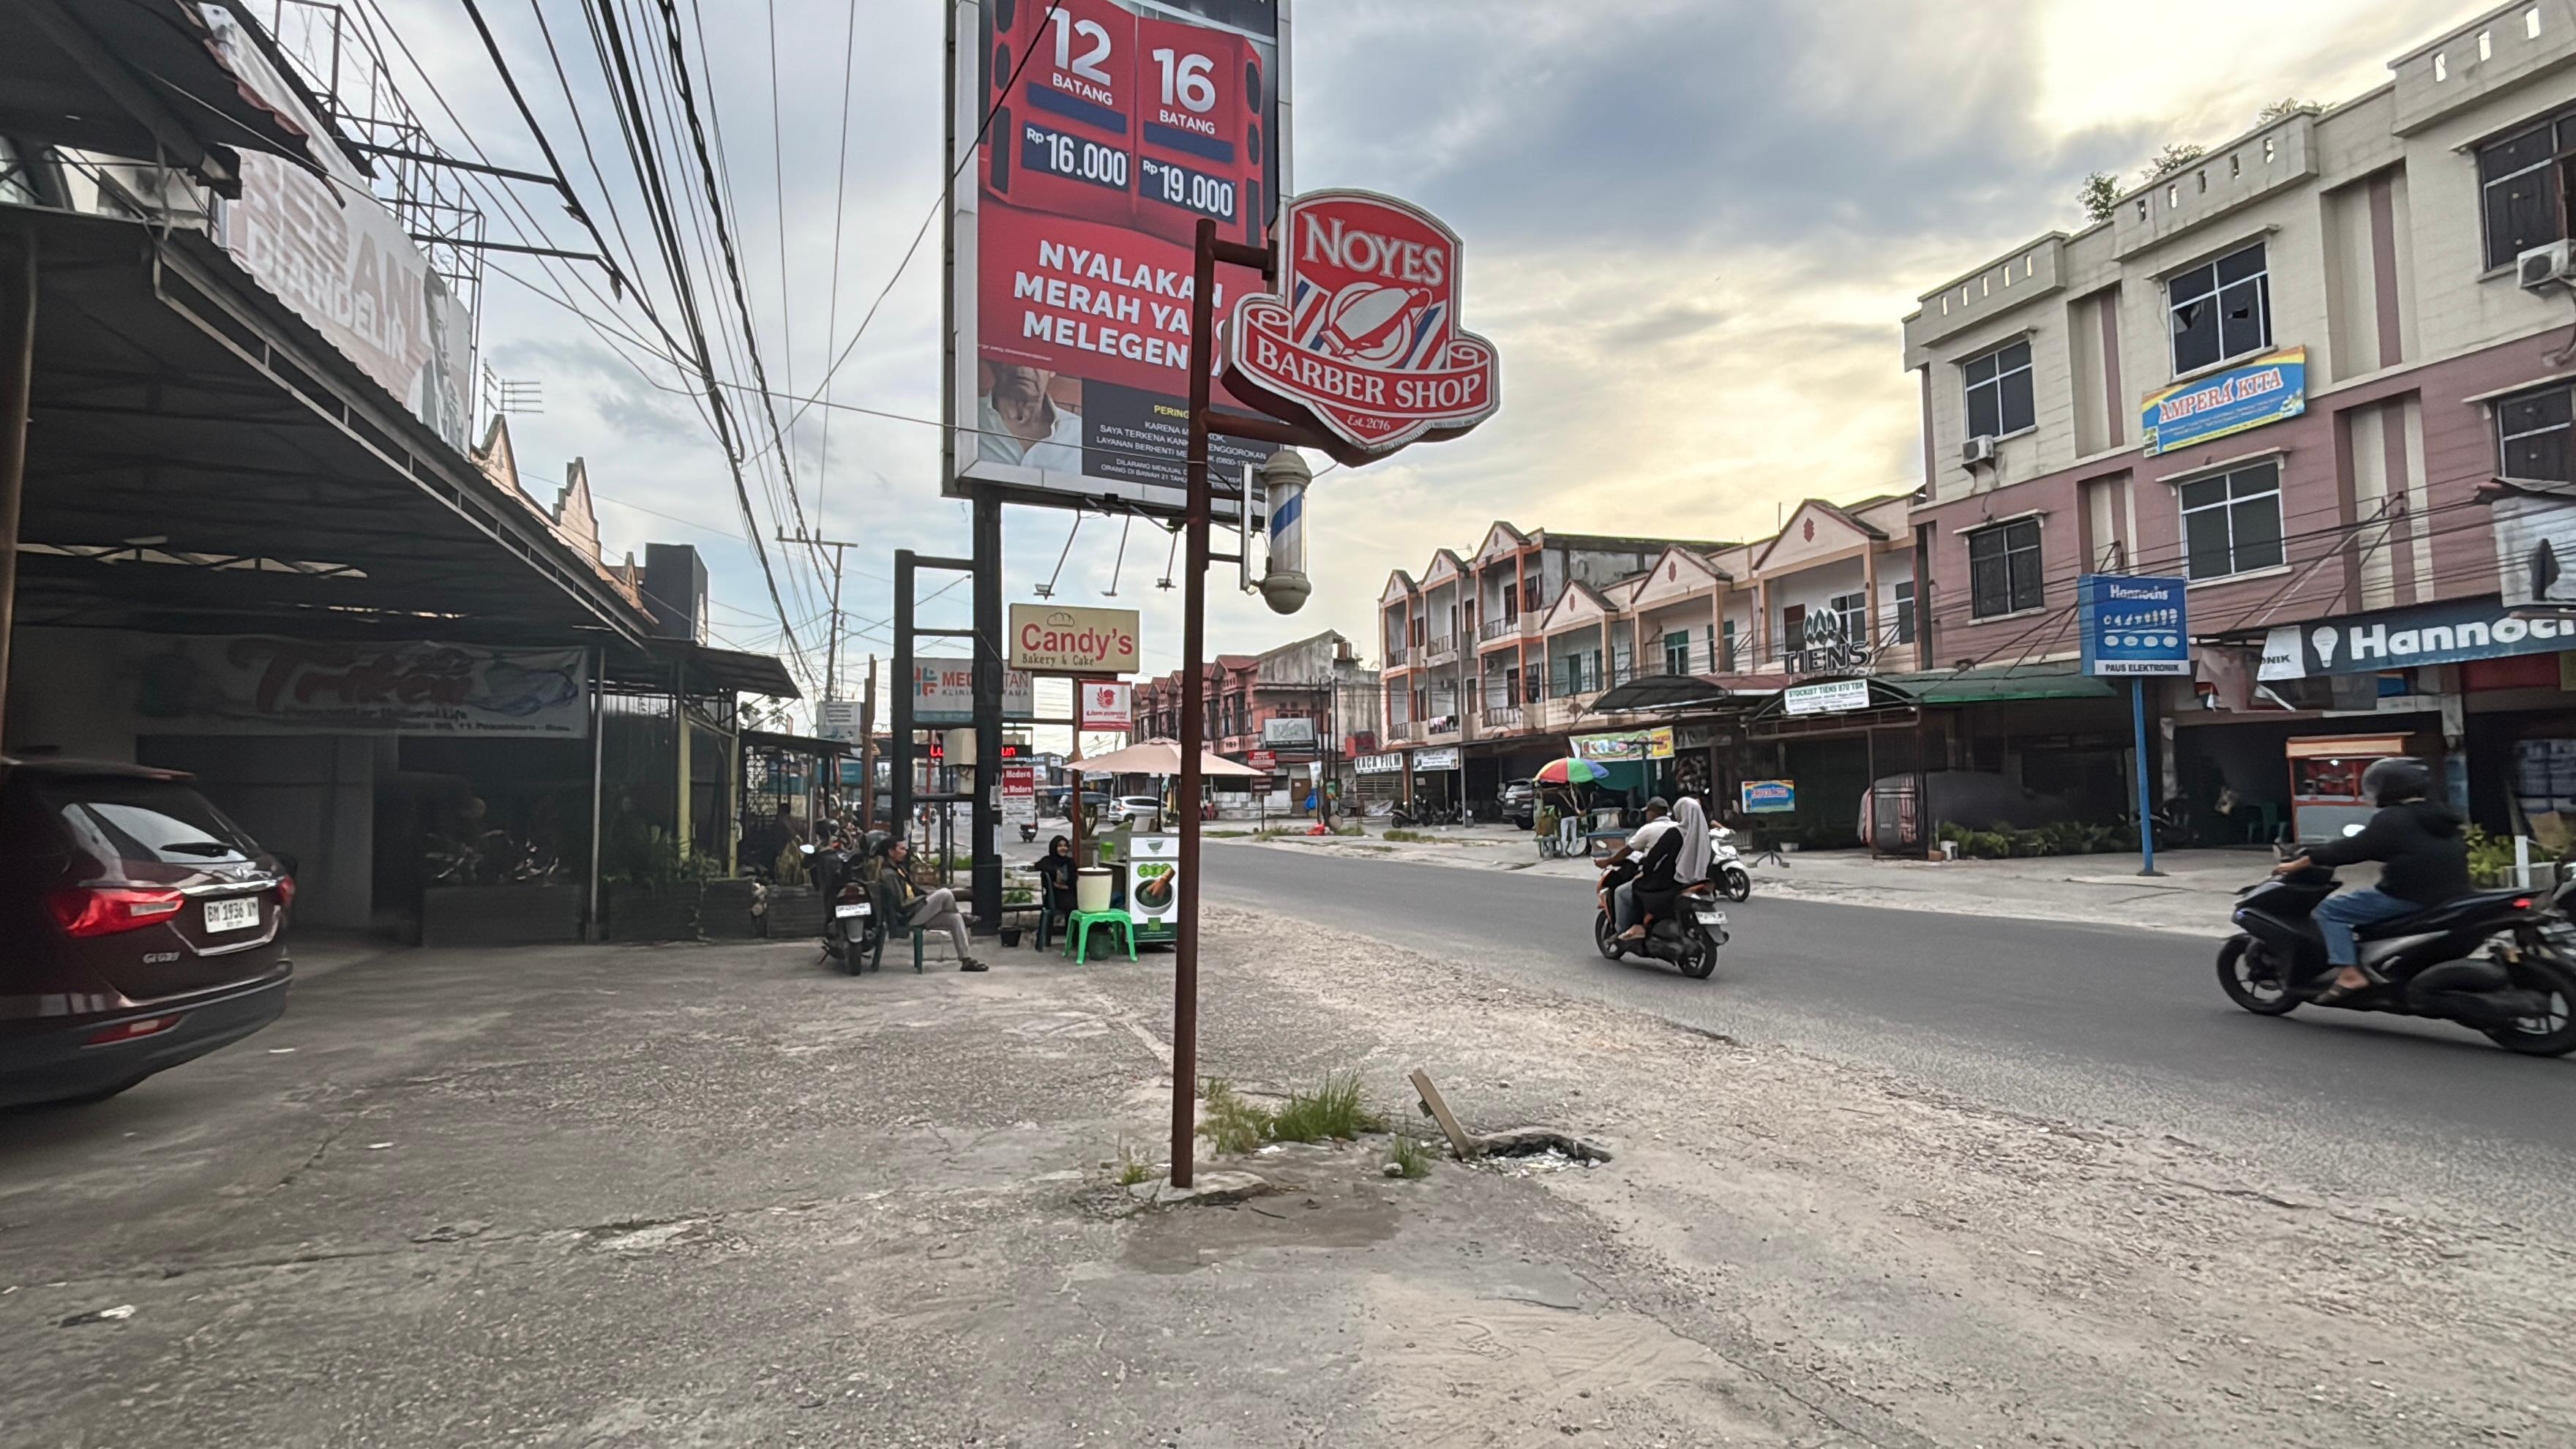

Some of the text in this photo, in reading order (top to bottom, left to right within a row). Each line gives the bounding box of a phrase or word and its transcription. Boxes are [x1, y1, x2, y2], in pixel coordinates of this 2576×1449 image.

[1046, 7, 1111, 86] 12
[1053, 72, 1112, 105] BATANG
[1153, 48, 1216, 113] 16
[1160, 109, 1215, 135] BATANG
[1300, 211, 1444, 287] NOYES
[1014, 271, 1140, 324] MERAH
[1257, 335, 1481, 408] BARBER SHOP
[2236, 367, 2283, 399] KITA
[1100, 424, 1123, 435] SAYA
[1124, 429, 1165, 443] TERKENA
[1145, 421, 1180, 434] KARENA
[1366, 417, 1390, 431] 2016
[1096, 435, 1133, 449] LAYANAN
[1135, 443, 1175, 455] BERHENTI
[1208, 443, 1266, 460] ENGGOROKAN
[1101, 464, 1126, 473] ORANG
[1136, 469, 1160, 479] BAWAH
[1116, 458, 1182, 475] DILARANG MENJUAL
[1021, 623, 1133, 661] Candy's
[2350, 618, 2575, 659] Hannoc
[1022, 653, 1056, 667] Bakery
[1073, 655, 1094, 666] Cake
[1781, 641, 1872, 674] TIENS
[2105, 664, 2179, 672] PAUS ELEKTRONIK
[1356, 755, 1401, 768] KACA FILM
